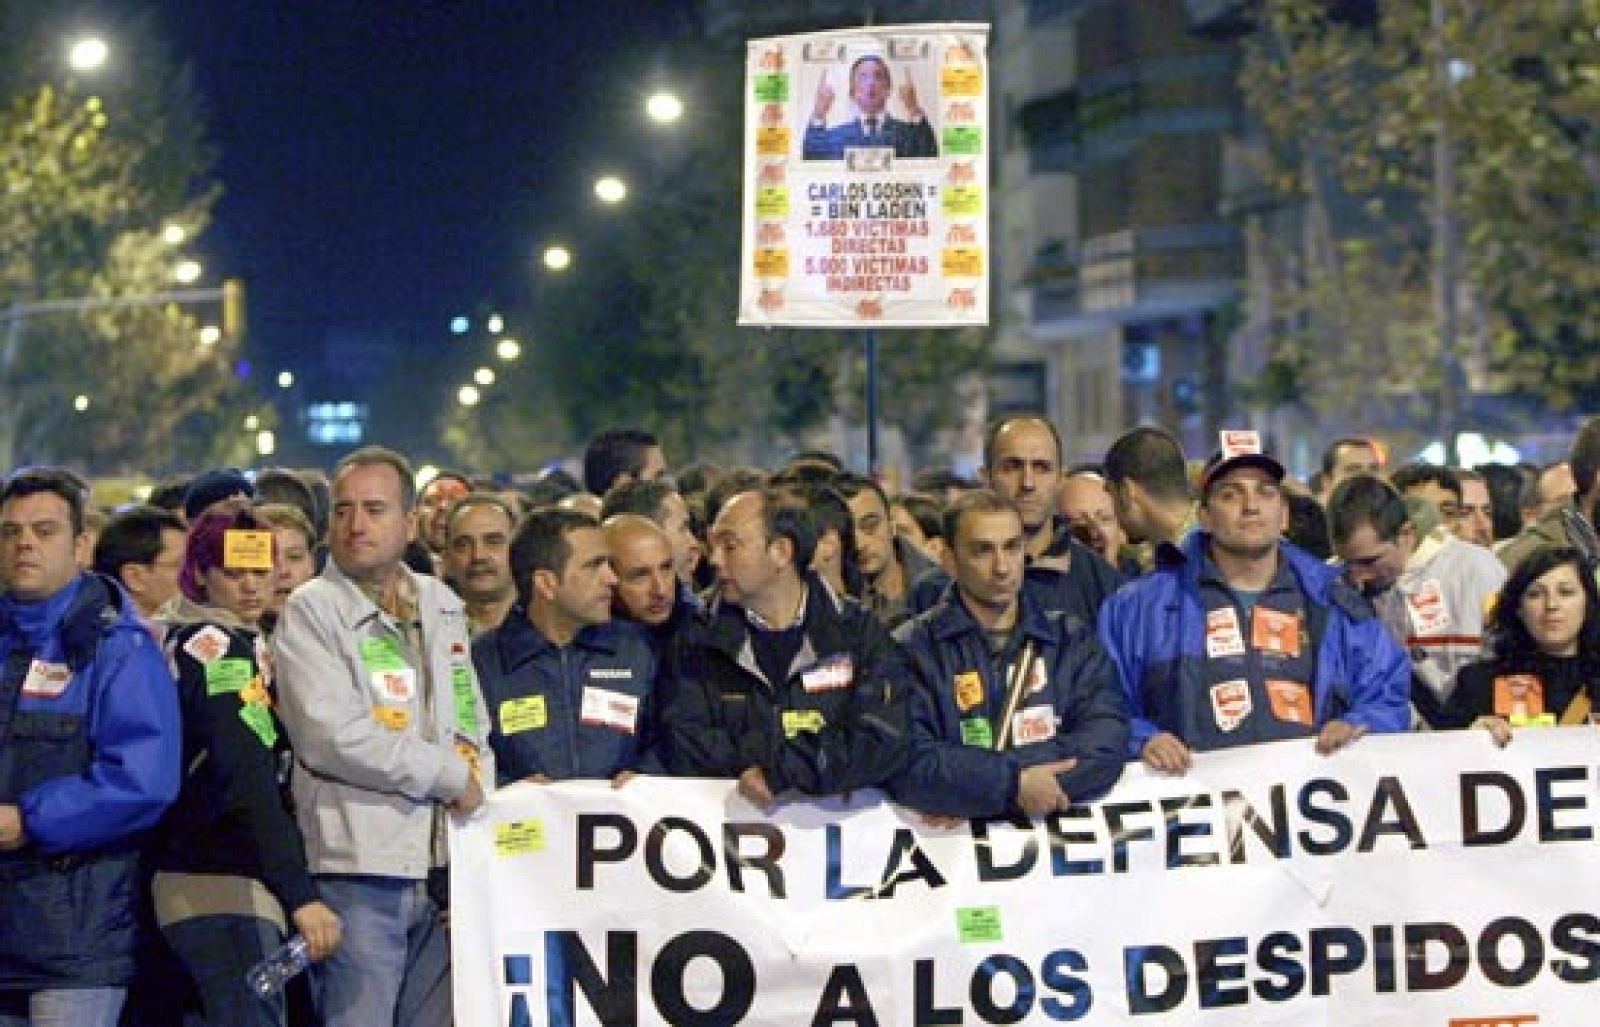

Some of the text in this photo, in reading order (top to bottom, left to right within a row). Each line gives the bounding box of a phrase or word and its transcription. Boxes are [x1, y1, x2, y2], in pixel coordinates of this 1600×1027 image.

[808, 182, 867, 201] CARLOS
[828, 202, 859, 219] BIN
[866, 200, 926, 219] LADEN
[831, 238, 906, 253] DIRECTAS
[825, 275, 912, 292] INDIRECTAS
[575, 765, 1600, 899] POR LA DEFENSA DE
[809, 963, 881, 1027] A
[912, 948, 1094, 1026] LOS
[1123, 912, 1600, 1015] DESPIDOS
